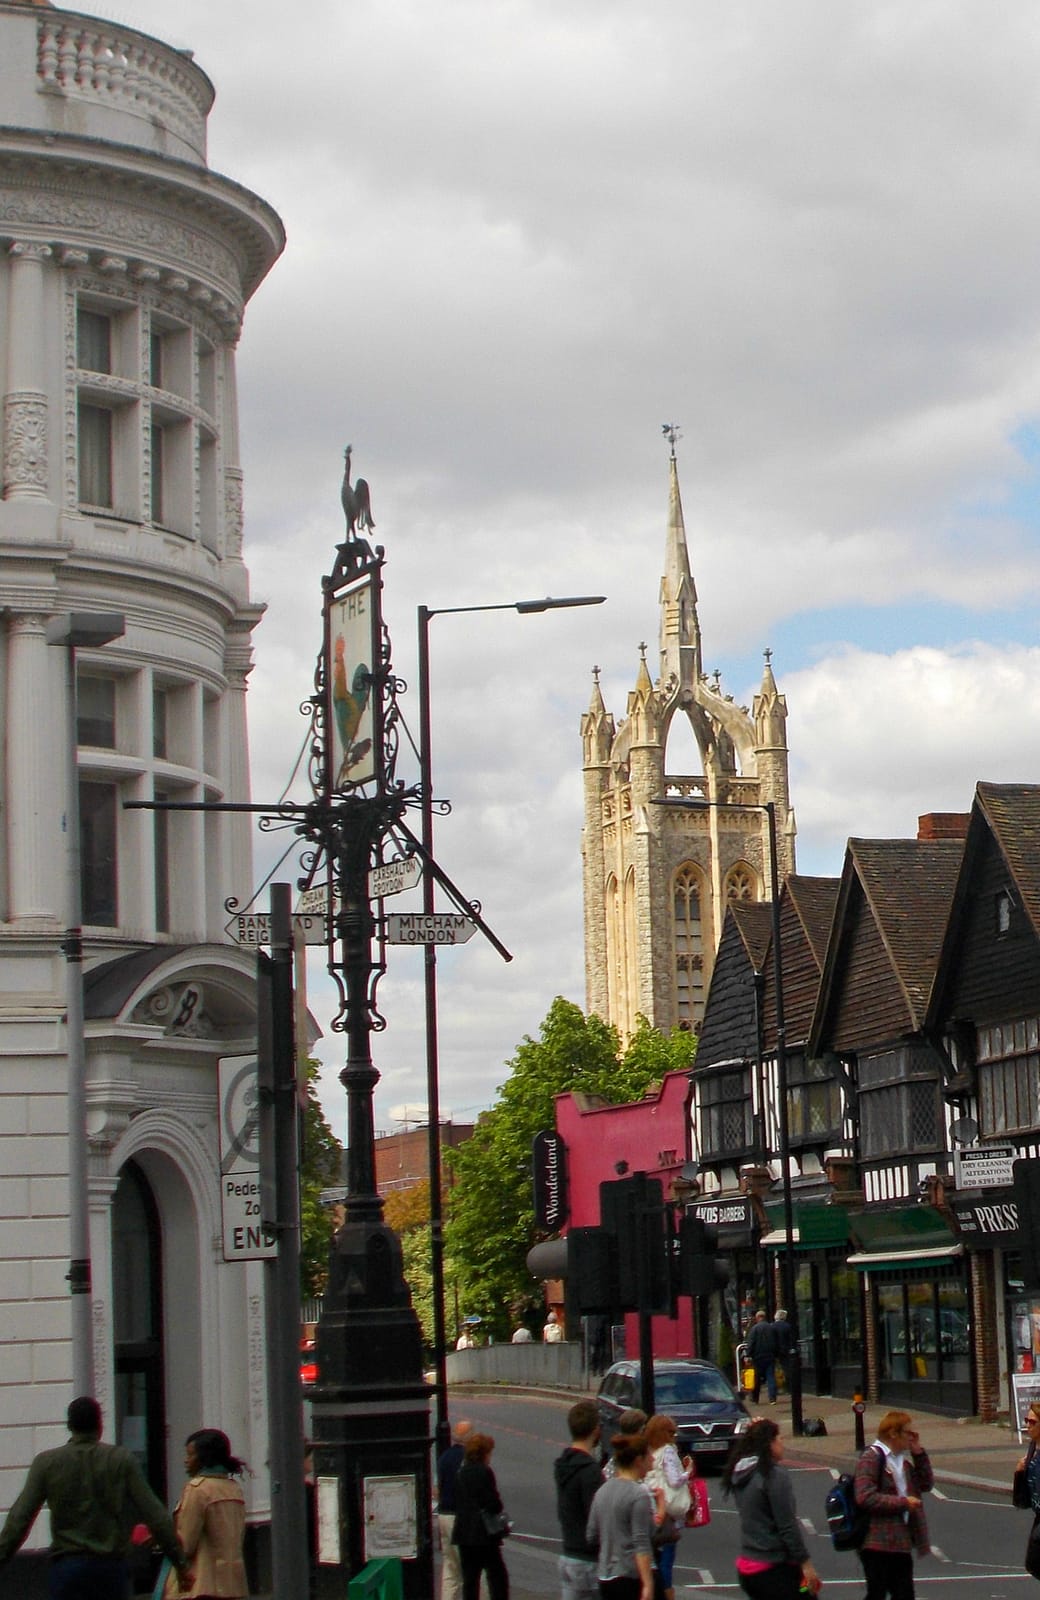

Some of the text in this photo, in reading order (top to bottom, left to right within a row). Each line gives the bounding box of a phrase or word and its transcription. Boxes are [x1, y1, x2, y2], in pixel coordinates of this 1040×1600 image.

[340, 591, 365, 624] THE
[373, 861, 416, 882] CARSHALTON
[302, 886, 324, 906] CHEAM
[373, 879, 404, 896] CROYDON
[400, 917, 465, 929] MITCHAM
[239, 930, 269, 942] REIG
[400, 930, 456, 942] LONDON
[544, 1138, 559, 1225] Wonderland
[966, 1169, 1011, 1177] ALTERATIONS
[245, 1201, 261, 1216] Zo
[719, 1206, 746, 1223] BARBERS
[974, 1204, 1019, 1233] PRESS
[232, 1226, 277, 1249] END
